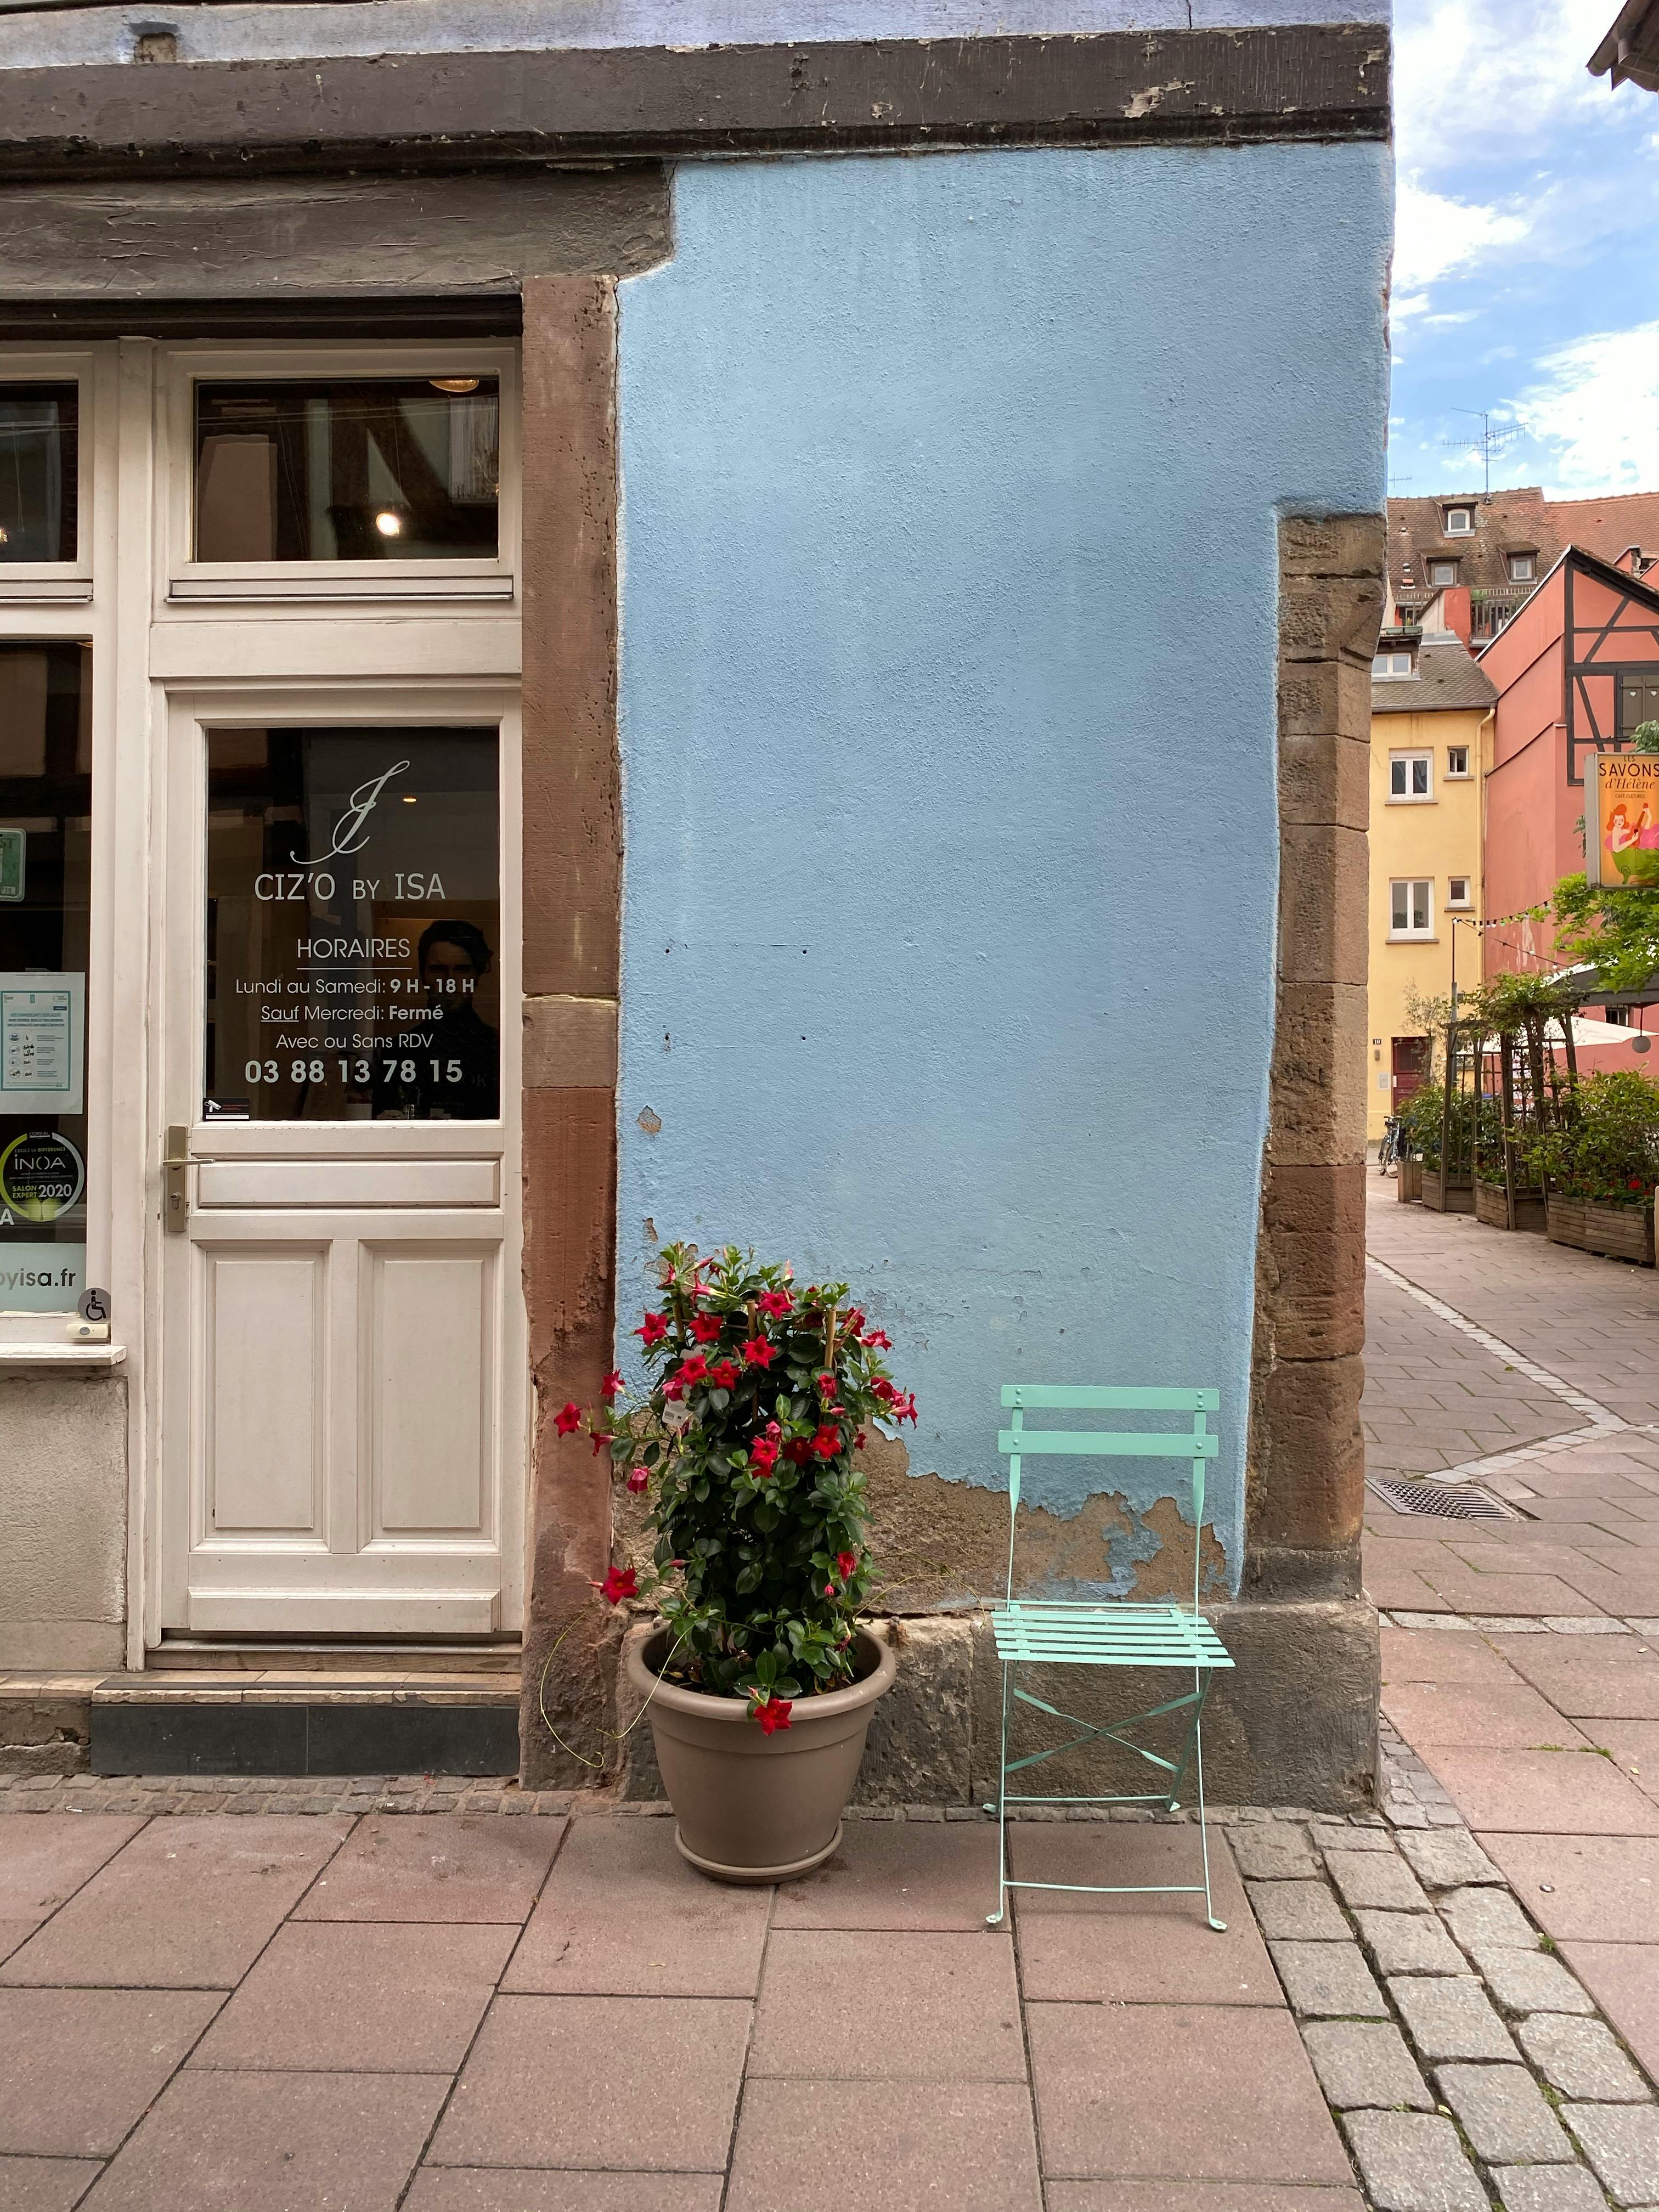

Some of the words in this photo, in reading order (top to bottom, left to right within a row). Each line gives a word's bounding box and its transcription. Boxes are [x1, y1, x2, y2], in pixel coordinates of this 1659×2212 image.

[1599, 763, 1659, 777] SAVONS
[1605, 778, 1655, 789] d'Hélène
[255, 872, 336, 900] CIZ'O
[353, 879, 380, 900] BY
[395, 873, 446, 900] ISA
[297, 938, 410, 958] HORAIRES
[236, 979, 281, 994] Lundi
[287, 983, 309, 994] au
[315, 979, 385, 994] Samedi:
[390, 979, 401, 993] 9
[407, 979, 419, 993] H
[436, 979, 456, 993] 18
[462, 979, 474, 993] H
[261, 1006, 300, 1020] Sauf
[304, 1006, 384, 1020] Mercredi:
[390, 1005, 444, 1020] Fermé
[275, 1034, 319, 1048] Avec
[324, 1037, 347, 1048] ou
[352, 1034, 393, 1048] Sans
[399, 1034, 433, 1048] RDV
[245, 1060, 279, 1083] 03
[291, 1060, 325, 1083] 88
[338, 1059, 370, 1083] 13
[383, 1059, 416, 1083] 78
[430, 1059, 462, 1083] 15
[38, 1183, 72, 1198] 2020
